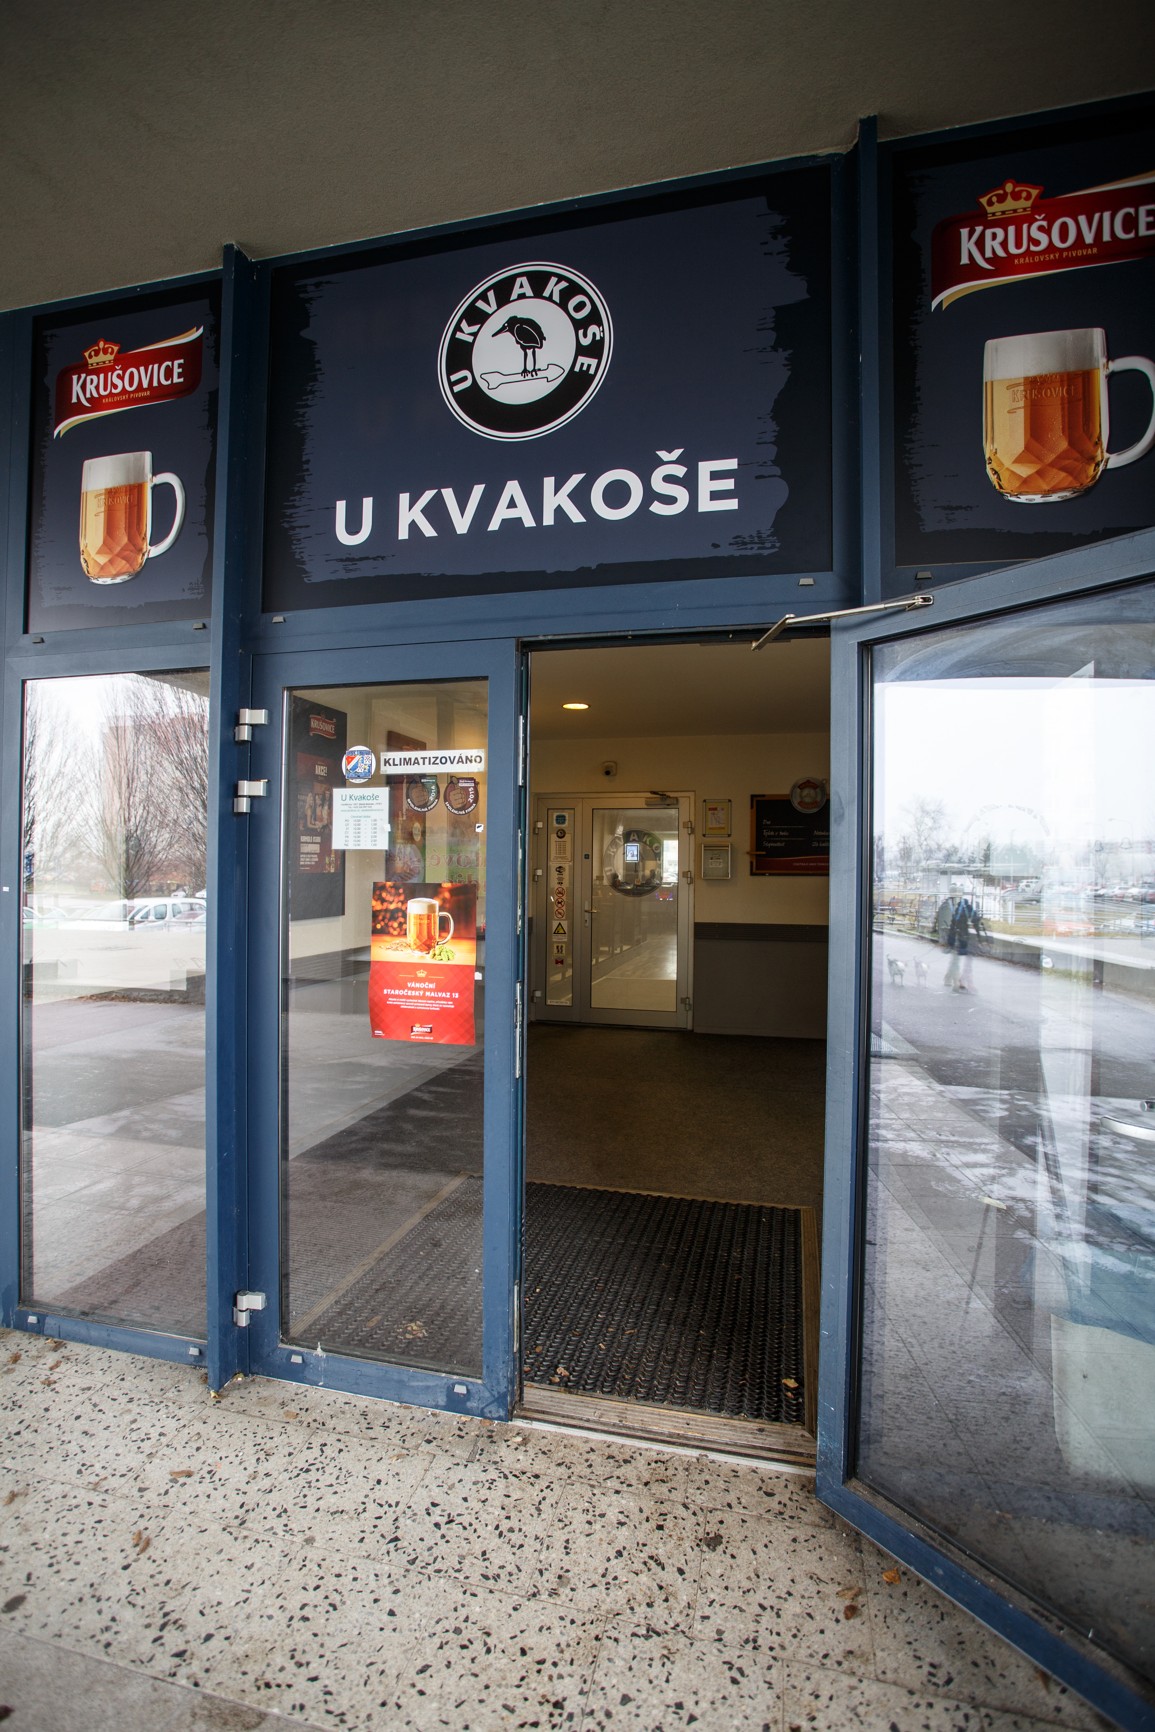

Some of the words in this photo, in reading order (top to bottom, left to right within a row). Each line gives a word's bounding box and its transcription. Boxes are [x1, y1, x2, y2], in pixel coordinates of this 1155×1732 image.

[960, 204, 1155, 270] KRUŠOVICE
[1014, 252, 1060, 265] KRÁLOVSKÝ
[1063, 247, 1098, 259] PIVOVAR
[455, 276, 605, 376] KVAKOŠE
[71, 358, 185, 407] KRUŠOVICE
[449, 368, 473, 393] U
[130, 390, 151, 399] PIVOVAR
[335, 497, 373, 546] U
[398, 448, 739, 540] KVAKOŠE
[383, 753, 483, 767] KLIMATIZOVÁNO
[349, 793, 380, 801] Kvakoše
[383, 988, 423, 996] STAROČESKÝ
[425, 990, 451, 998] MALVAZ
[407, 981, 436, 989] VÁNOČNÍ
